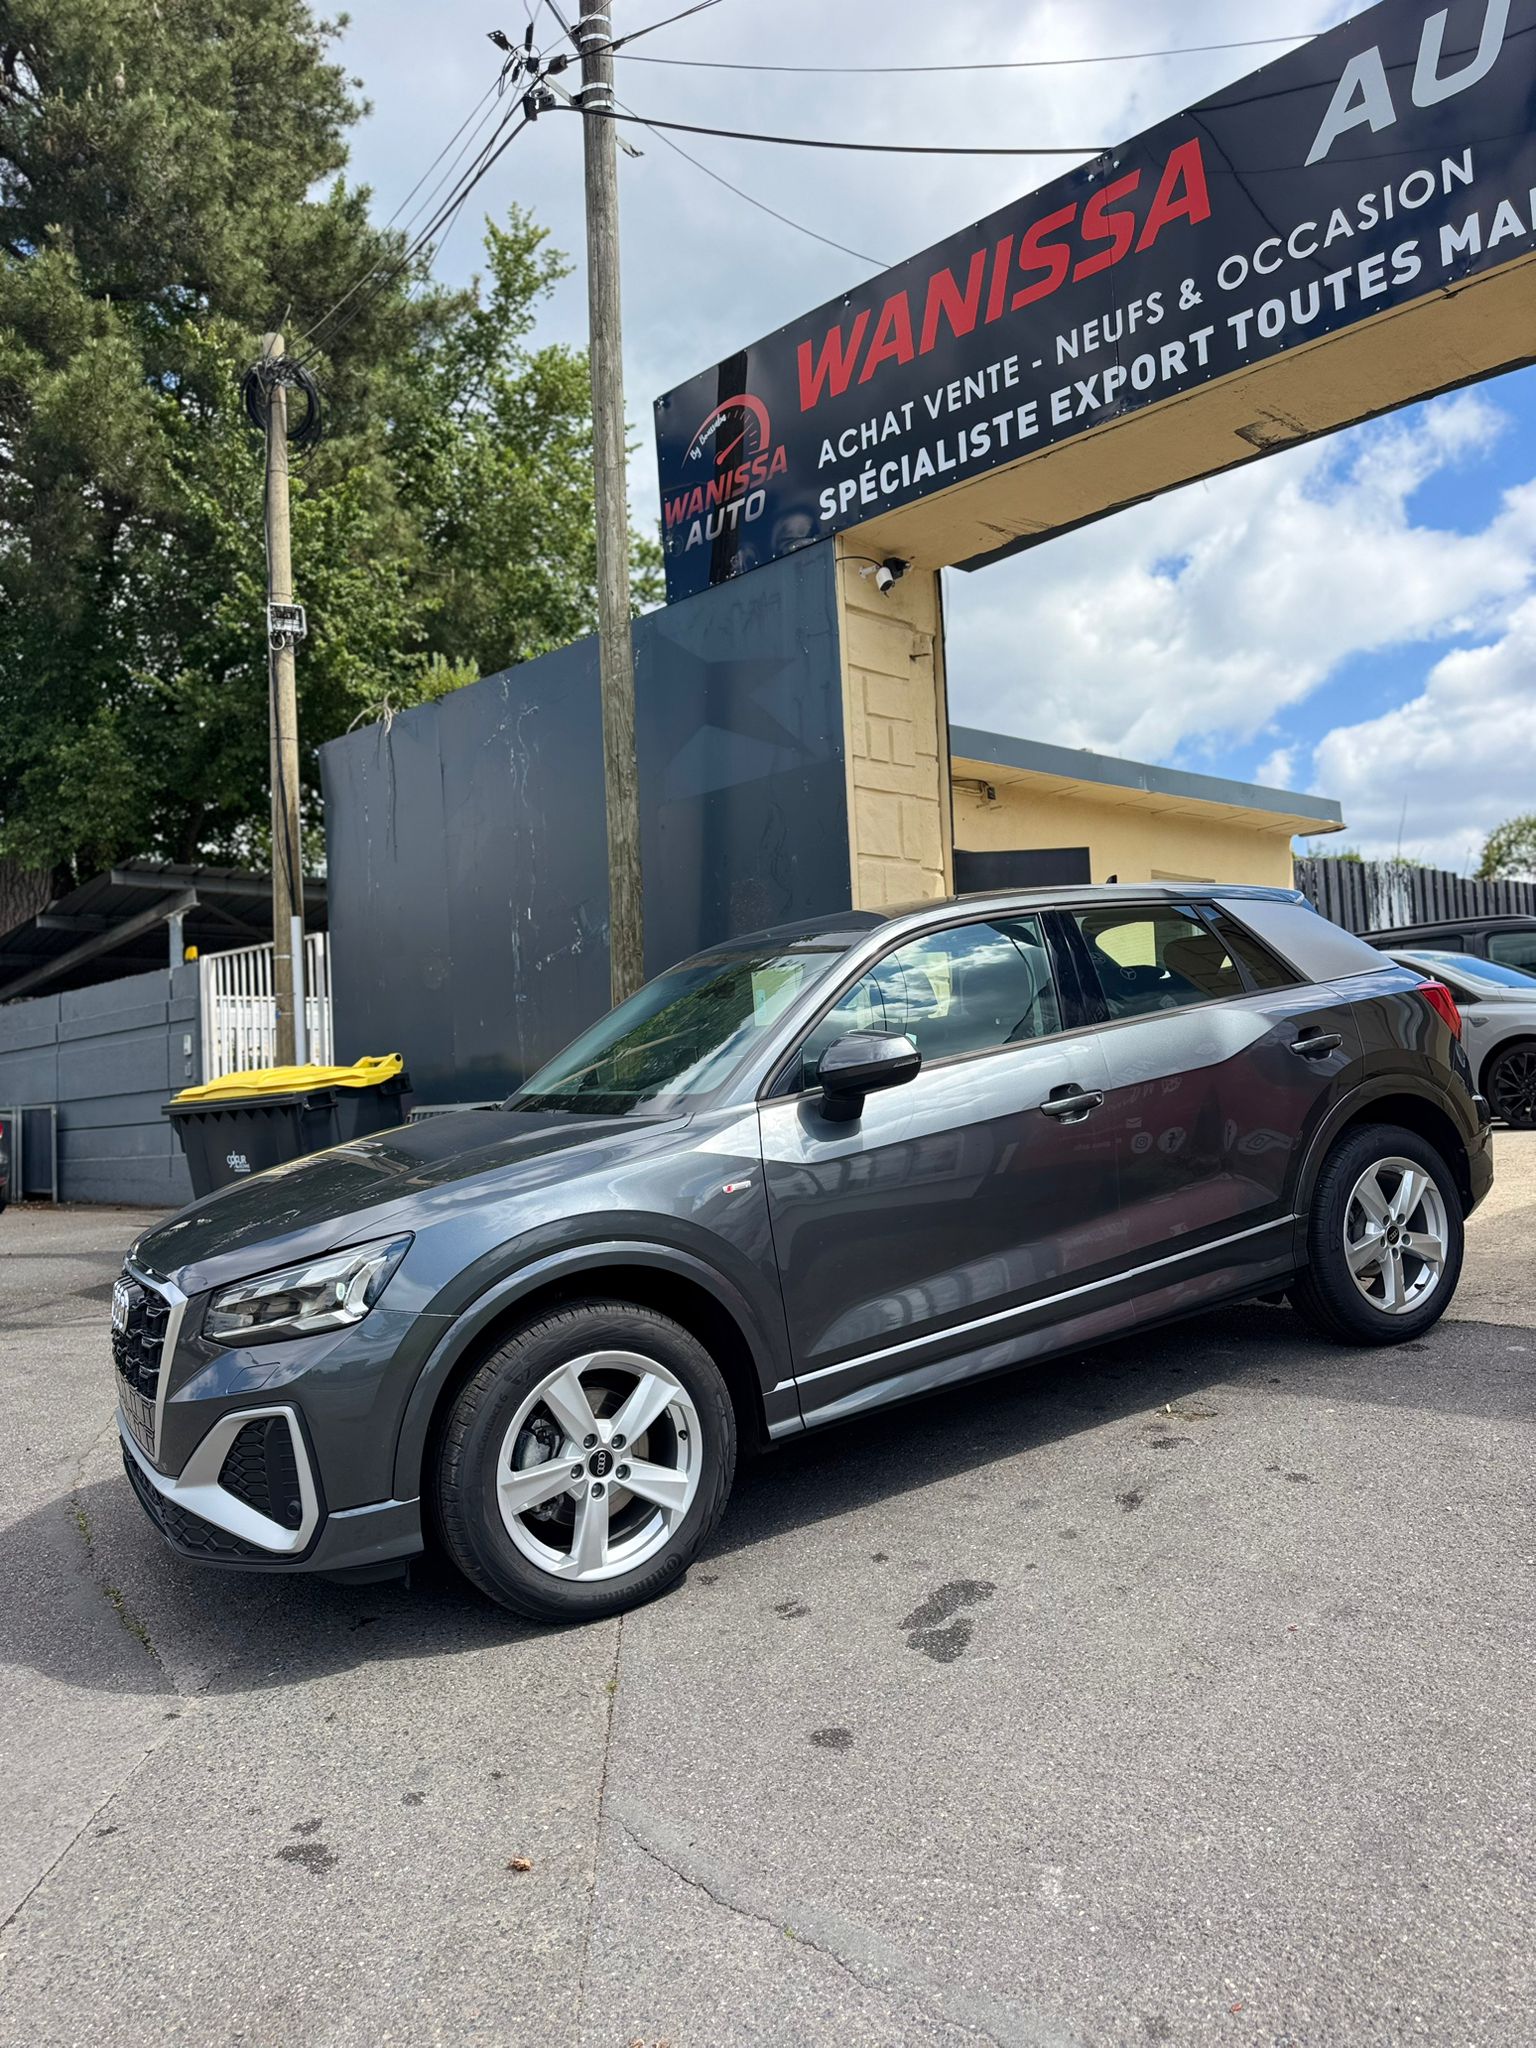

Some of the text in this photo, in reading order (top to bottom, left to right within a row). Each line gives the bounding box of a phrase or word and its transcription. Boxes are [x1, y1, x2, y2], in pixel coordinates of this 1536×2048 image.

[796, 0, 1511, 413] WANISSA AU
[818, 401, 915, 470] ACHAT
[923, 354, 1020, 421] VENTE
[1055, 291, 1165, 366] NEUFS
[1178, 277, 1204, 311] &
[1216, 147, 1475, 291] OCCASION
[818, 186, 1536, 522] SPÉCIALISTE EXPORT TOUTES MA
[664, 444, 788, 529] WANISSA
[684, 488, 766, 552] AUTO
